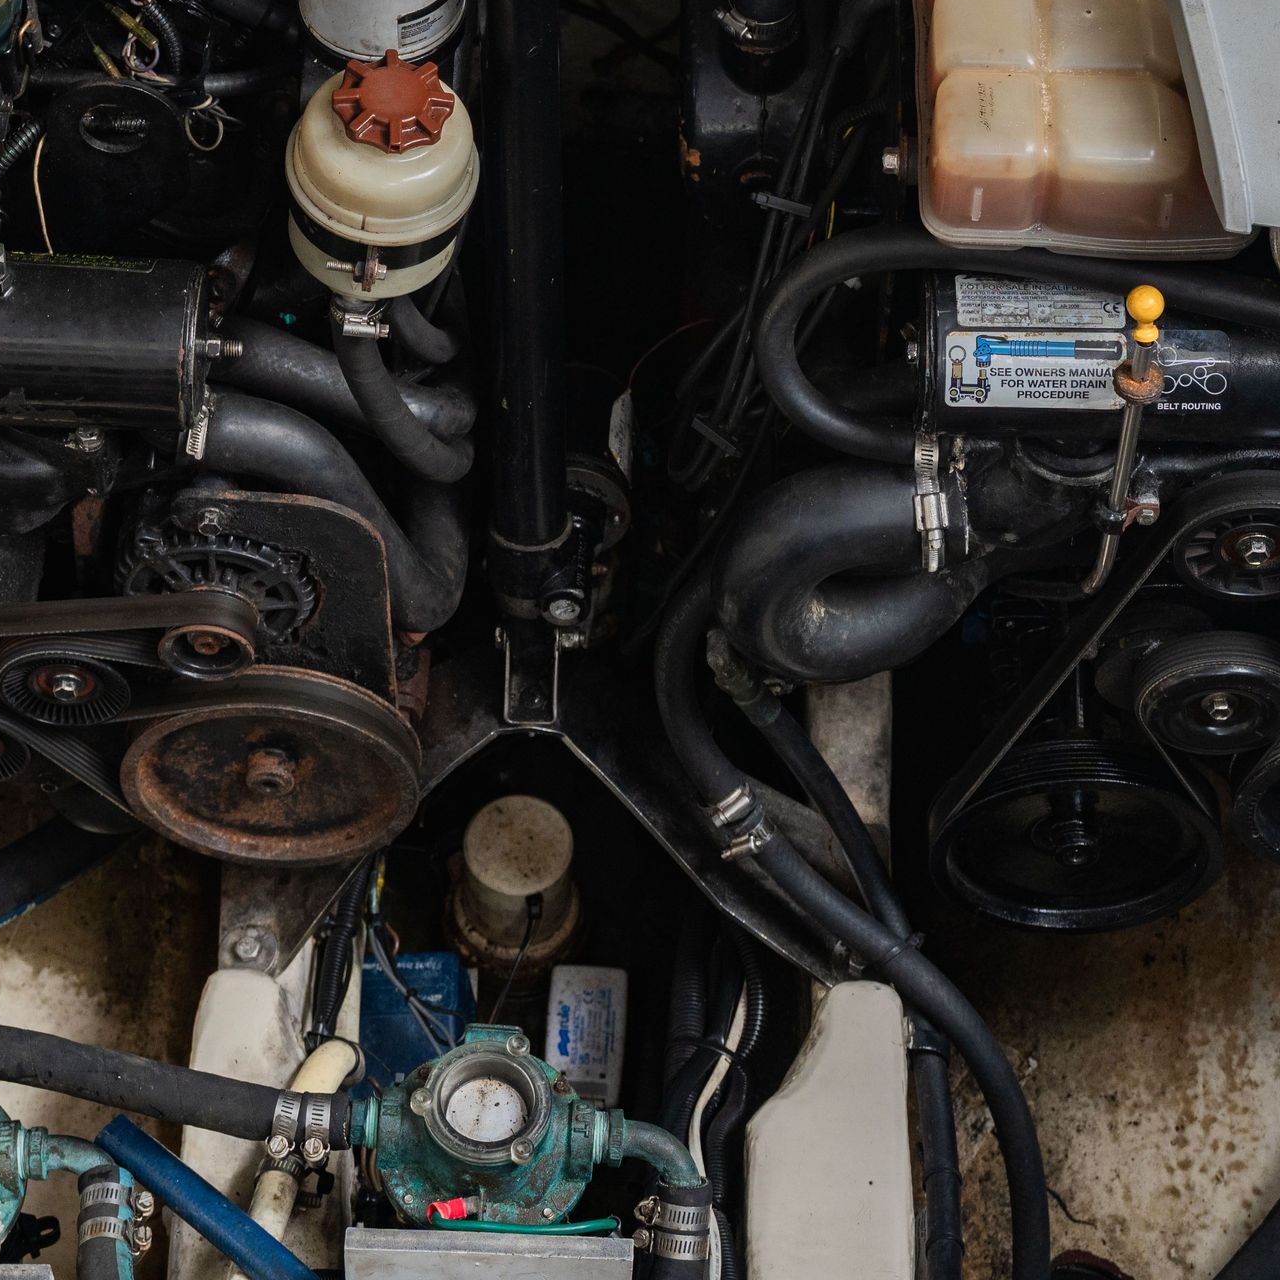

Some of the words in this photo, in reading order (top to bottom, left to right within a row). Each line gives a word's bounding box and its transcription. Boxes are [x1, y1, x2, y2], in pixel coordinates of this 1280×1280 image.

[1103, 302, 1121, 314] CE
[989, 367, 1012, 377] SEE
[1015, 367, 1066, 377] OWNERS
[1001, 379, 1025, 388] FOR
[1028, 379, 1068, 388] WATER
[1070, 380, 1107, 389] DRAIN
[1017, 390, 1090, 399] PROCEDURE
[1157, 402, 1180, 410] BELT
[1181, 402, 1222, 411] ROUTING
[573, 1103, 591, 1139] OUT
